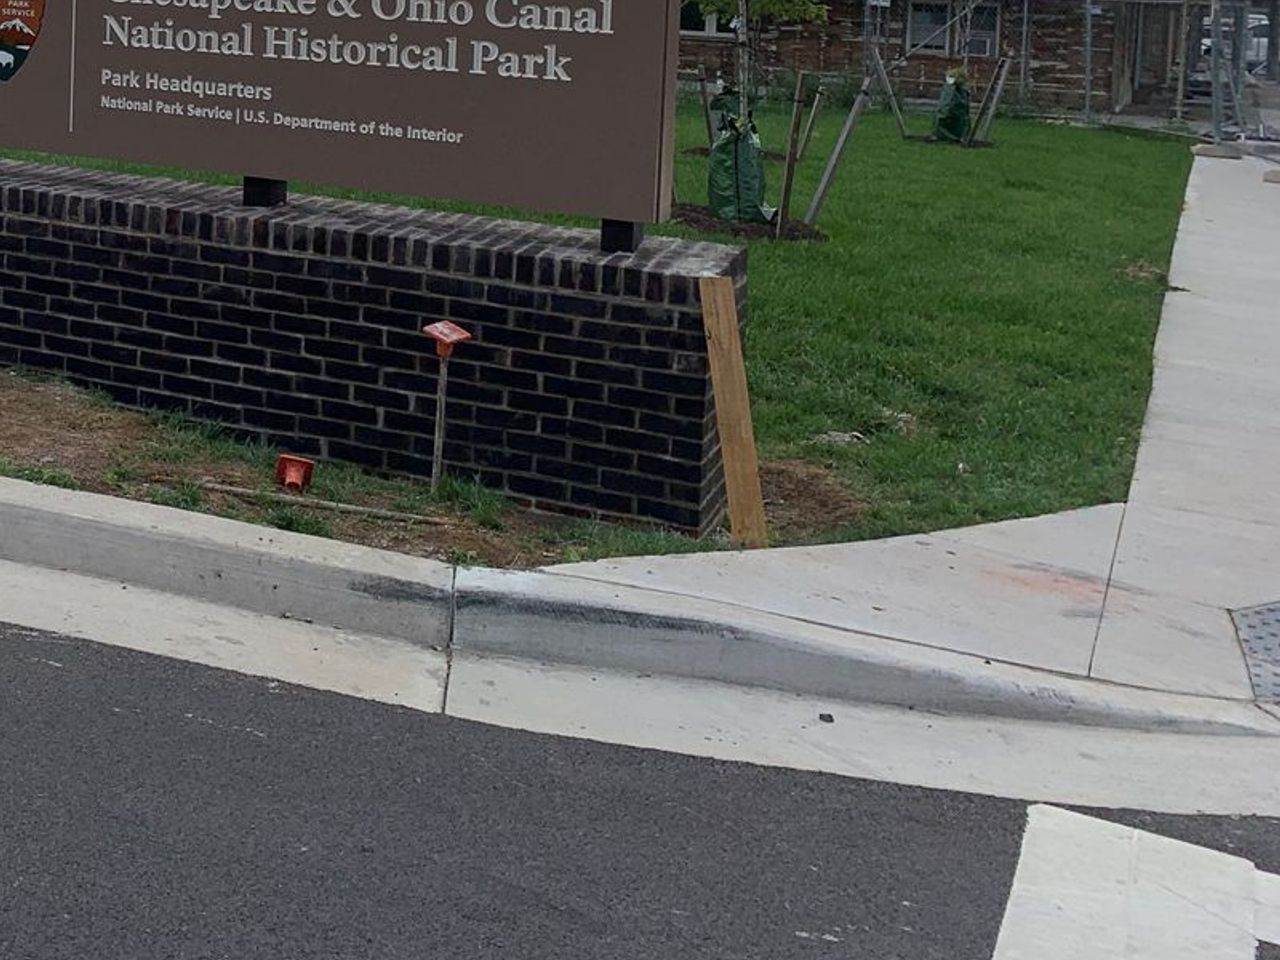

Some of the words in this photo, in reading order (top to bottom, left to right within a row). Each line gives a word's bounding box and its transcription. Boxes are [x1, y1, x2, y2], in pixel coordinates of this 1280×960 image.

[1, 8, 35, 17] SERVICE
[7, 0, 30, 8] PARK
[102, 14, 254, 57] National
[262, 25, 459, 73] Historical
[469, 39, 572, 81] Park
[100, 68, 140, 88] Park
[145, 72, 272, 100] Headquarters
[100, 95, 152, 113] National
[155, 100, 184, 116] Park
[187, 103, 233, 120] Service
[243, 109, 270, 125] U.S.
[273, 112, 356, 133] Department
[359, 120, 376, 135] of
[378, 122, 403, 138] the
[406, 125, 463, 144] Interior
